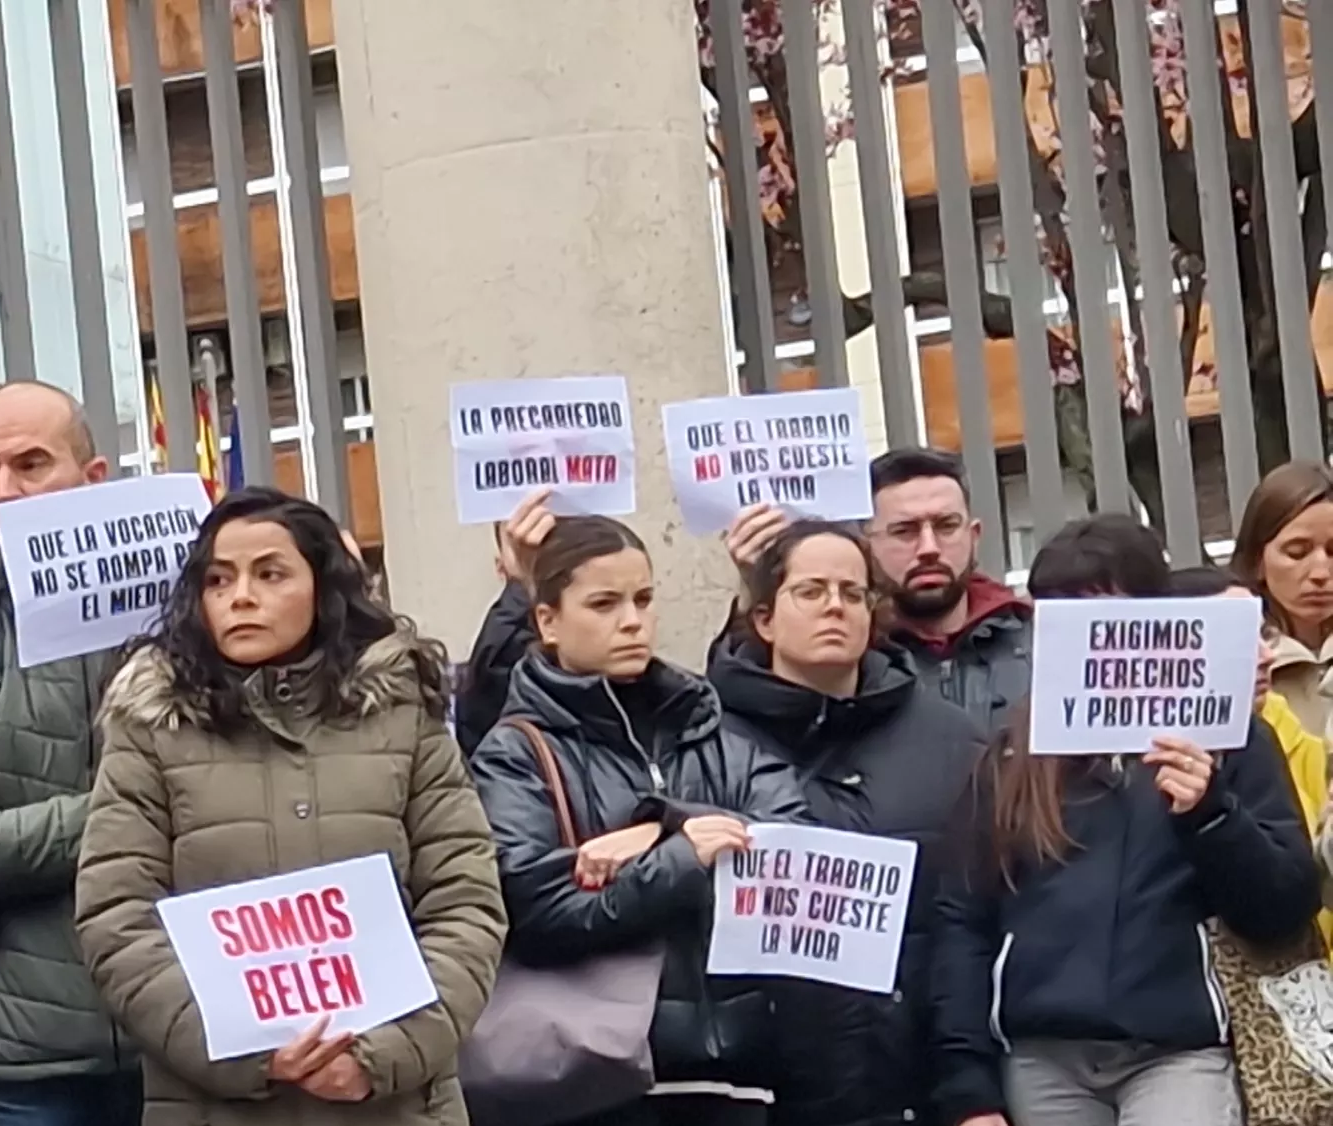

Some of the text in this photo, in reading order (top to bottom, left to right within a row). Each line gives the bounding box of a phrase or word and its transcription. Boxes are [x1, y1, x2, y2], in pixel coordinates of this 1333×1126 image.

[460, 401, 622, 436] LA PRECARIEDAD
[687, 413, 851, 451] QUE EL TRABAJO
[475, 455, 617, 491] LABORAL MATA
[694, 444, 853, 482] NO NOS CUESTE
[737, 475, 816, 507] LA VIDA
[27, 530, 69, 563] QUE
[73, 524, 98, 552] LA
[31, 568, 58, 597] NO
[65, 561, 91, 591] SE
[97, 546, 168, 585] ROMPA
[81, 579, 170, 622] EL MIEDO
[1090, 618, 1204, 651] EXIGIMOS
[1083, 657, 1207, 690] DERECHOS
[1062, 690, 1233, 729] Y PROTECCIÓN
[733, 849, 901, 899] QUE EL TRABAJO
[211, 887, 352, 957] SOMOS
[735, 886, 892, 933] NO NOS CUESTE
[761, 923, 841, 962] LA VIDA
[244, 948, 363, 1021] BELÉN
